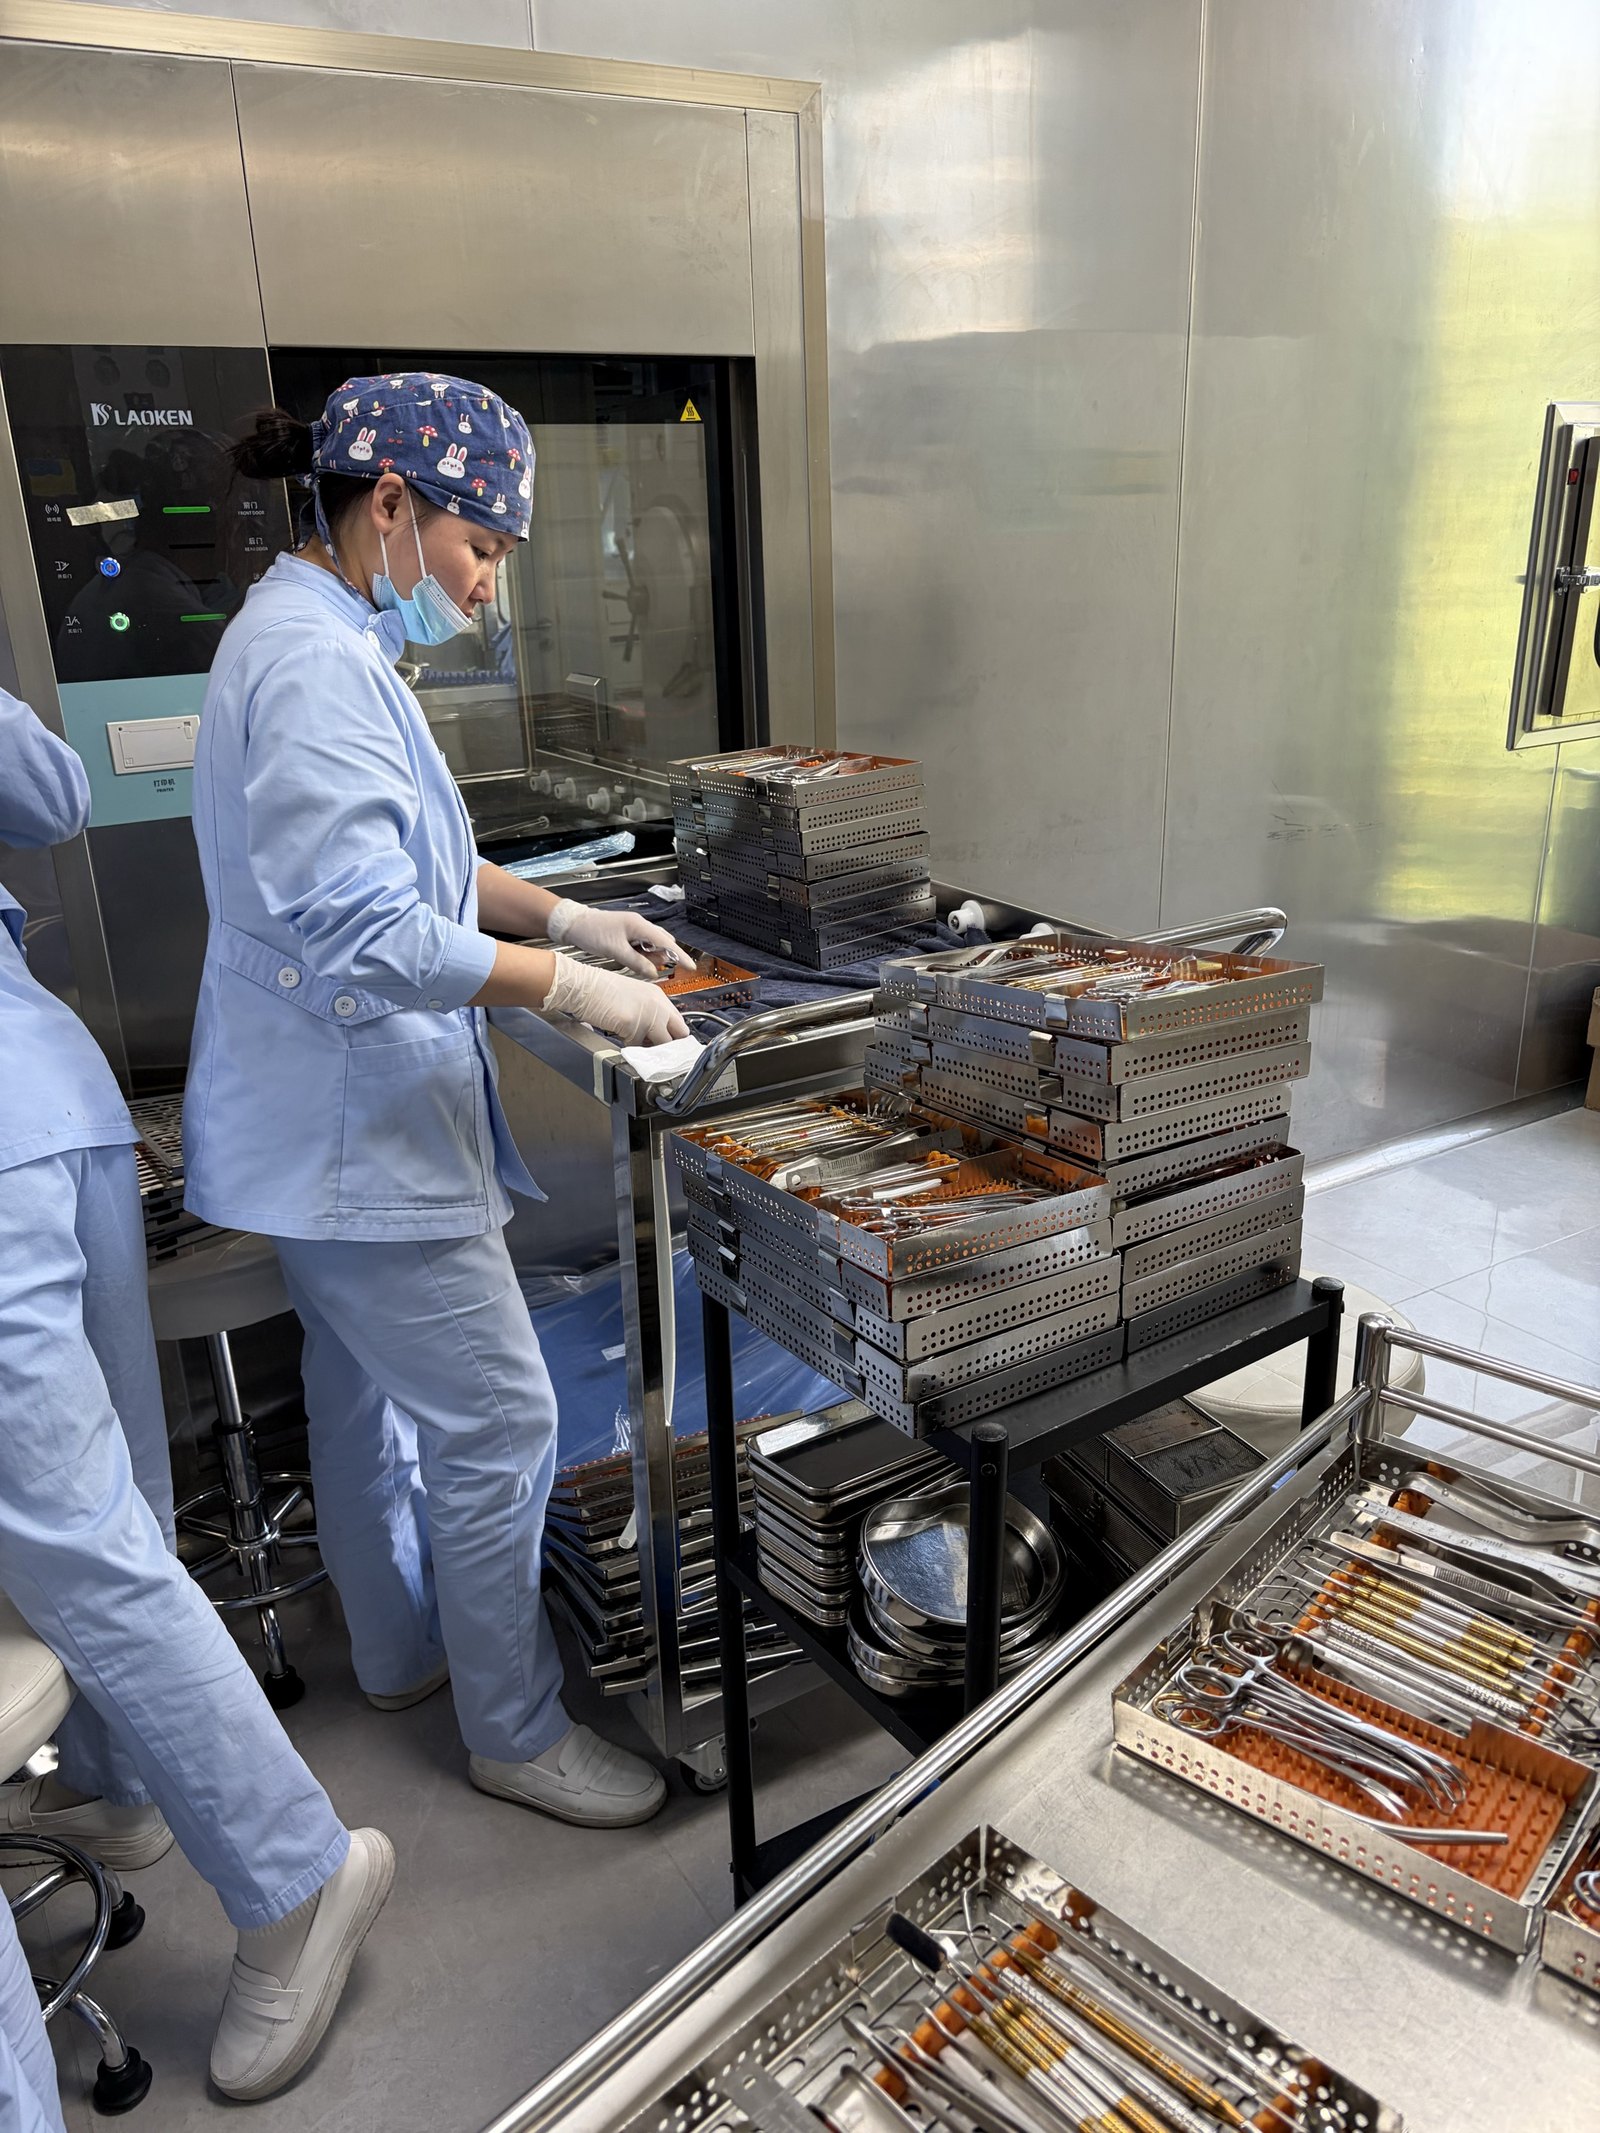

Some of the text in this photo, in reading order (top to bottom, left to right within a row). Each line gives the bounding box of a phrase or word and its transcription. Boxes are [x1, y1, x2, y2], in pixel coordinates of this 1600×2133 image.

[114, 409, 194, 426] LAOKEN
[153, 779, 175, 787] 打印机
